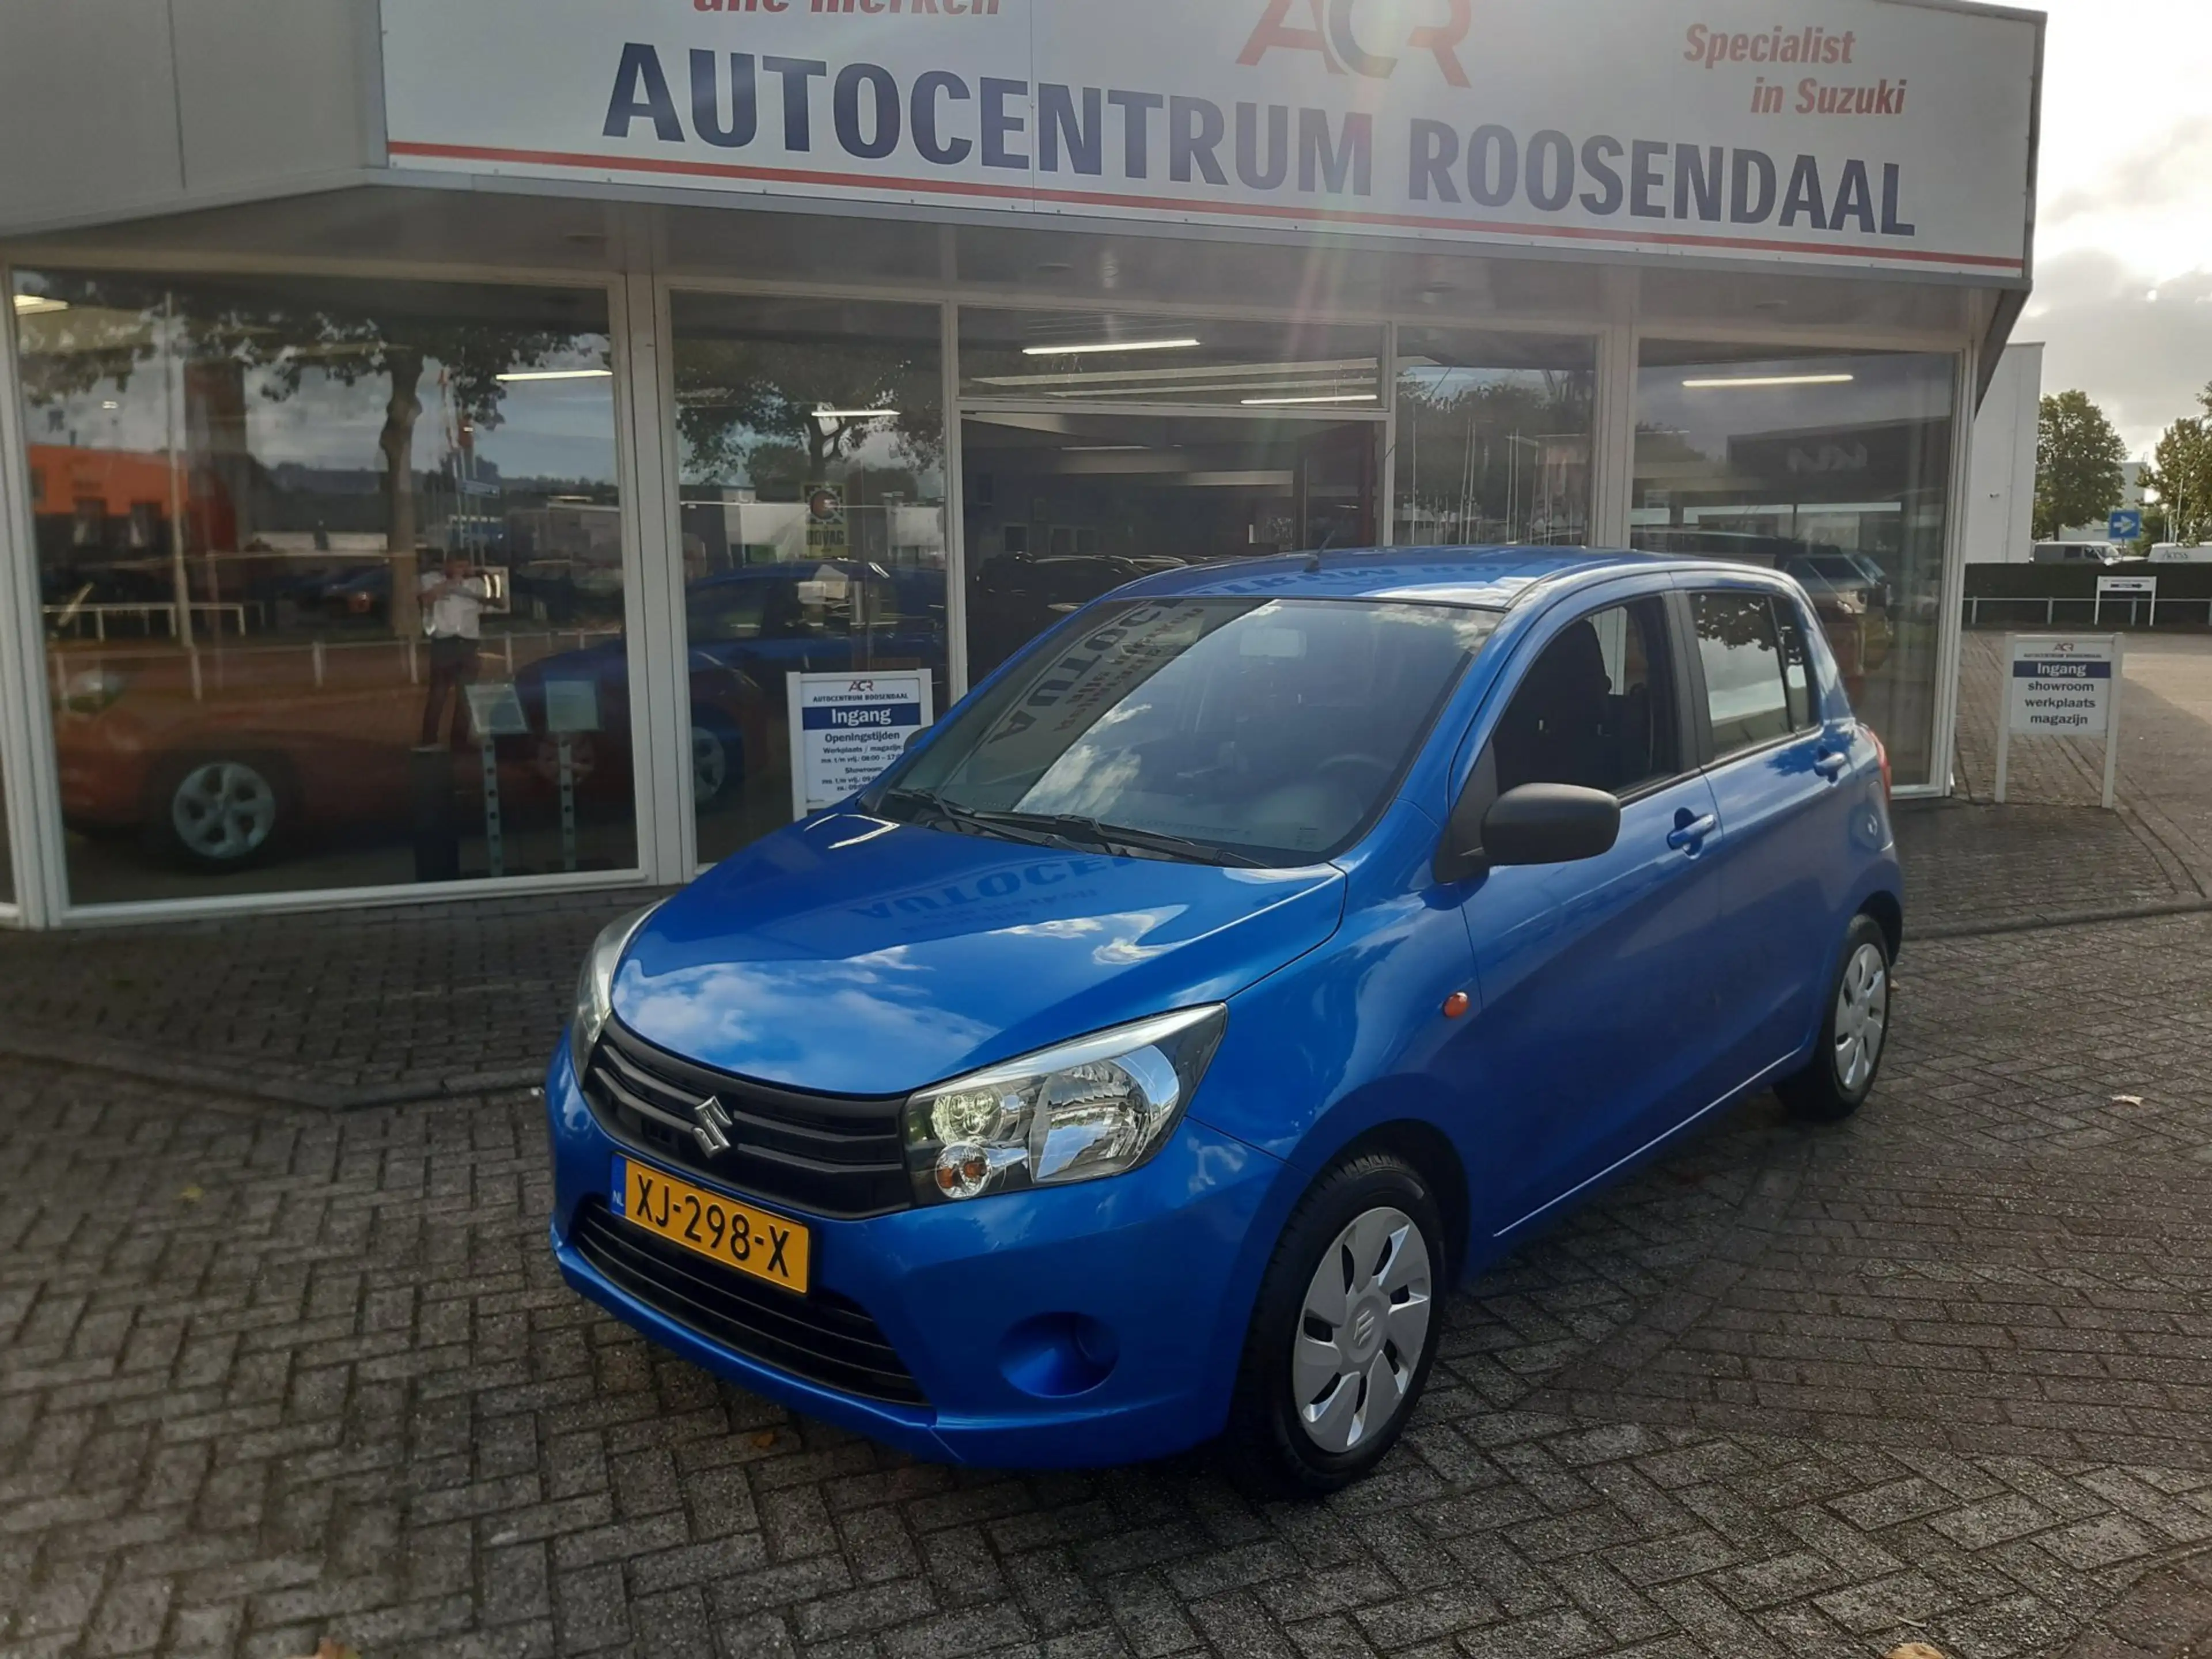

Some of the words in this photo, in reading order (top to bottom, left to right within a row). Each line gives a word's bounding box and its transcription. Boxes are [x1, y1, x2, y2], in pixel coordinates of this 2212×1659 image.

[1684, 24, 1856, 69] Specialist
[1751, 77, 1784, 113] in
[1795, 77, 1907, 115] Suzuki
[602, 42, 1373, 196] AUTOCENTRUM
[1408, 118, 1915, 236] ROOSENDAAL
[2037, 663, 2087, 677] Ingang
[849, 680, 874, 692] ACR
[2028, 681, 2094, 692] showroom
[813, 694, 863, 702] AUTOCENTRUM
[2025, 698, 2096, 709] werkplaats
[832, 709, 892, 726] Ingang
[2030, 714, 2088, 726] magazijn
[825, 732, 900, 744] Openingstijden
[612, 1190, 624, 1207] NL
[636, 1172, 790, 1278] XJ-298-X
